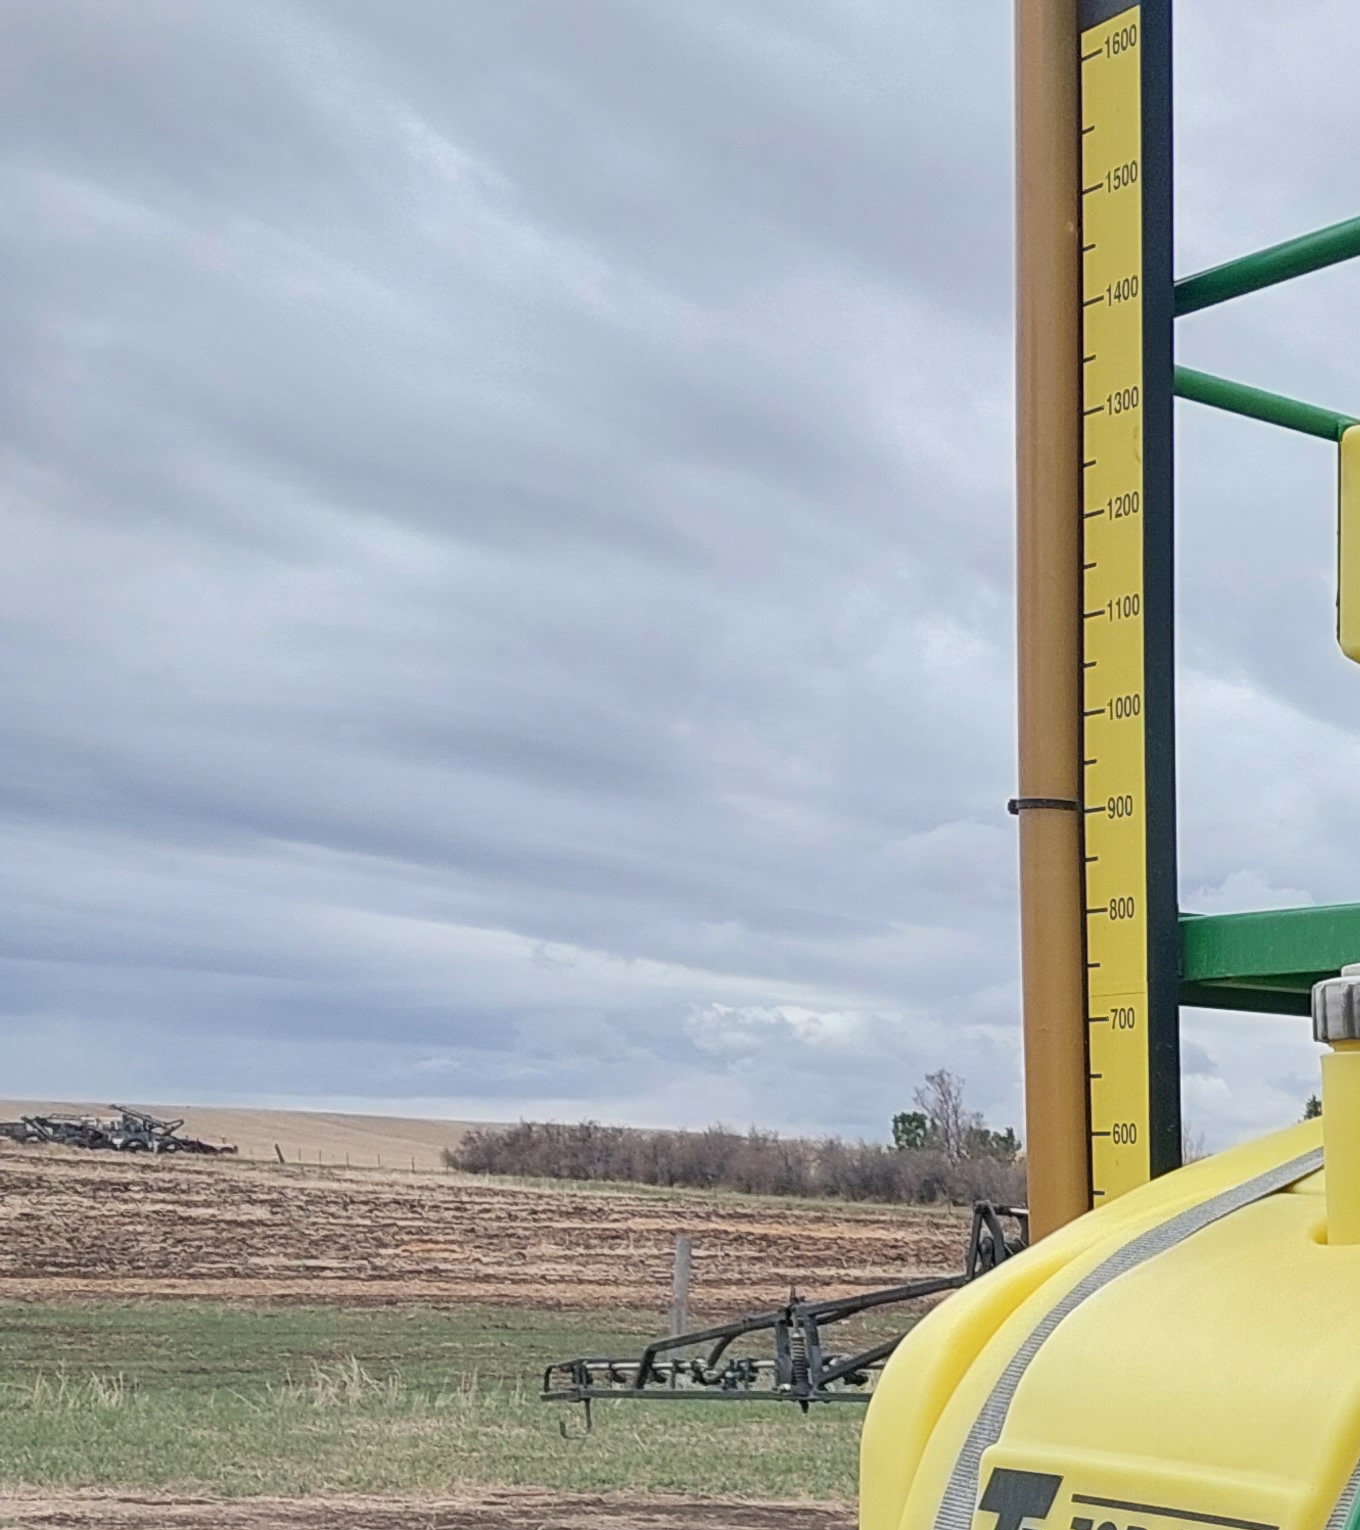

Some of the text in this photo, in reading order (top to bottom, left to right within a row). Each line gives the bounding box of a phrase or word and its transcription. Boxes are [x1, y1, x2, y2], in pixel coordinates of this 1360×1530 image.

[1104, 24, 1138, 58] 1600
[1104, 161, 1138, 193] 1500
[1105, 275, 1139, 306] 1400
[1106, 386, 1139, 417] 1300
[1106, 491, 1140, 521] 1200
[1106, 594, 1140, 622] 1100
[1107, 694, 1141, 721] 1000
[1107, 796, 1133, 819] 900
[1109, 897, 1135, 920] 800
[1110, 1008, 1136, 1031] 700
[1112, 1123, 1138, 1145] 600
